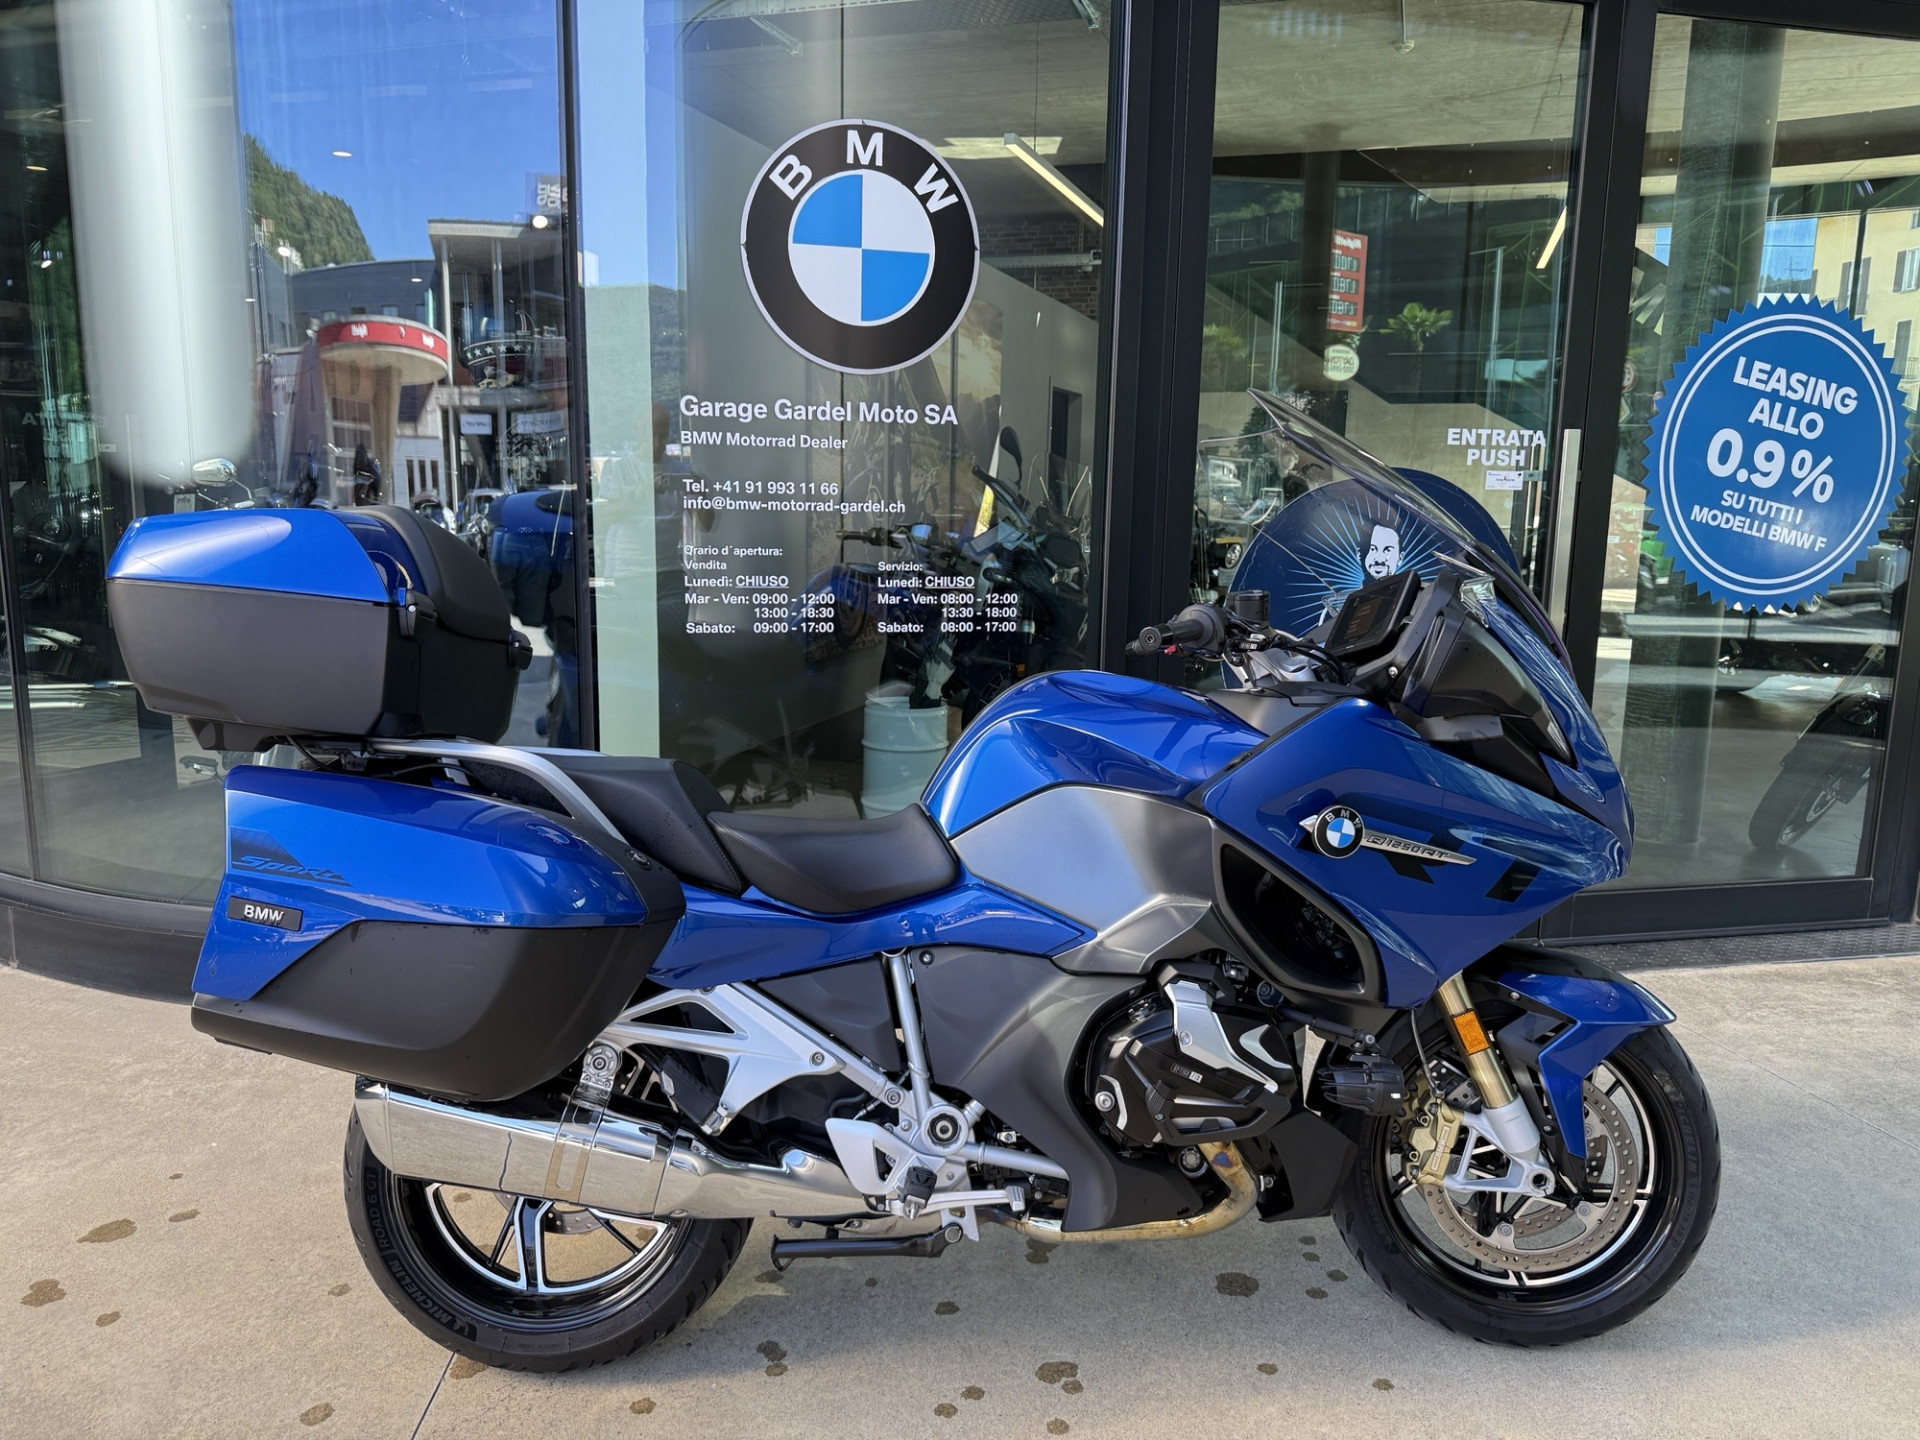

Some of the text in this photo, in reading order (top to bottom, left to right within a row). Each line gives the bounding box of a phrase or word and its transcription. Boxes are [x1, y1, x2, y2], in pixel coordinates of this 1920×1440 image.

[769, 129, 959, 213] BMW
[1732, 355, 1858, 415] LEASING
[679, 394, 958, 425] Garage Gardel Moto SA
[1748, 397, 1824, 440] ALLO
[680, 430, 848, 449] BMW Motorrad Dealer
[1447, 428, 1547, 447] ENTRATA
[1466, 448, 1526, 467] PUSH
[682, 479, 839, 496] Tel. +41 91 993 11 66
[683, 496, 906, 513] info@bmw-motorrad-gardel.ch
[1721, 489, 1803, 525] SU TUTTI I
[1690, 504, 1827, 552] MODELLI BMW F
[684, 544, 719, 556] Orario
[684, 560, 727, 570] Vendita
[877, 561, 923, 571] Servizio:
[684, 575, 789, 588] Lunedì: CHIUSO
[877, 576, 975, 589] Lunedì: CHIUSO
[684, 593, 710, 604] Mar
[721, 593, 749, 604] Ven:
[752, 593, 788, 605] 09:00
[800, 593, 835, 604] 12:00
[877, 593, 901, 604] Mar
[911, 593, 938, 605] Ven:
[941, 593, 974, 604] 08:00
[985, 593, 1018, 604] 12:00
[754, 607, 788, 618] 13:00
[800, 607, 835, 618] 18:30
[941, 607, 974, 618] 13:30
[985, 607, 1017, 618] 18:00
[685, 622, 736, 634] Sabato:
[753, 622, 788, 633] 09:00
[800, 622, 834, 633] 17:00
[877, 622, 924, 633] Sabato:
[941, 621, 974, 632] 08:00
[984, 621, 1017, 632] 17:00
[1325, 808, 1362, 829] BMW
[231, 855, 346, 881] Sport
[243, 904, 285, 921] BMW
[366, 1174, 390, 1249] ROAD 6 GT
[388, 1259, 451, 1326] MICHELIN
